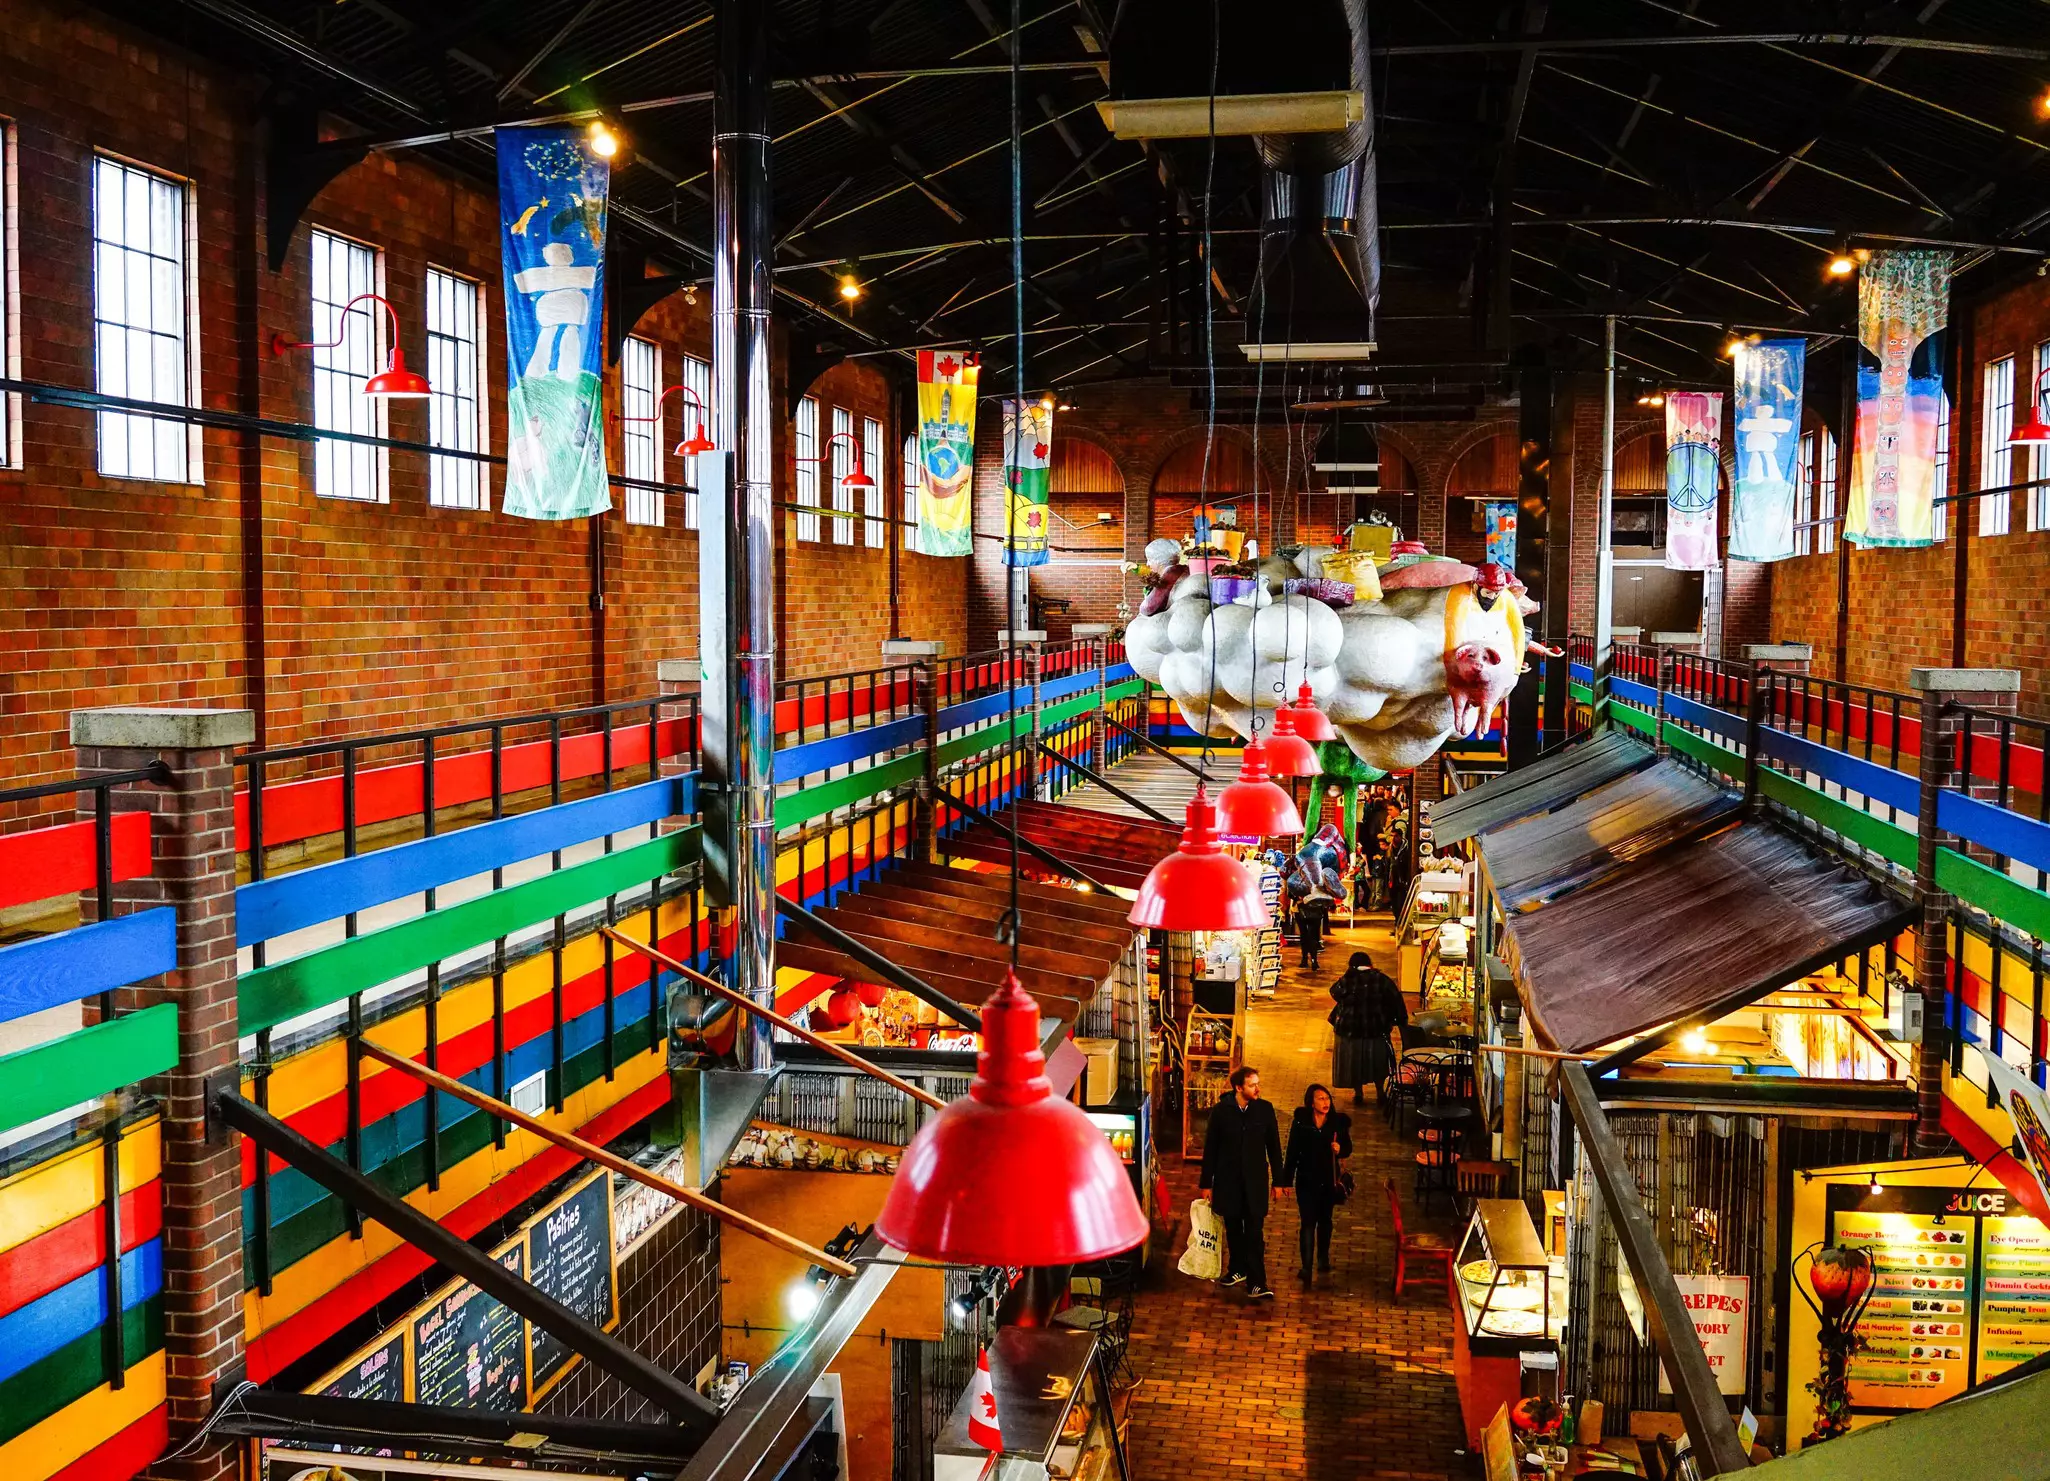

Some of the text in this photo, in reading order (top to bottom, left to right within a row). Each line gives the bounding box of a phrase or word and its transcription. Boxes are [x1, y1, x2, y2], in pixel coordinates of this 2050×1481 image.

[1946, 1194, 2005, 1211] JUICE
[546, 1204, 580, 1247] Pastries
[1841, 1230, 1873, 1240] Orange
[1990, 1235, 2040, 1244] Eye Opener
[1879, 1254, 1910, 1264] Orange
[1989, 1258, 2041, 1267] Power Plant
[1885, 1278, 1905, 1286] Kiwi
[1988, 1280, 2022, 1289] Vitamin
[1681, 1294, 1743, 1314] REPES
[1988, 1305, 2047, 1314] Pumping Iron
[1695, 1323, 1731, 1335] VORY
[1871, 1322, 1904, 1332] Sunrise
[1987, 1327, 2022, 1335] Infusion
[1986, 1350, 2036, 1359] Wheatgrass
[360, 1348, 389, 1380] SALADS
